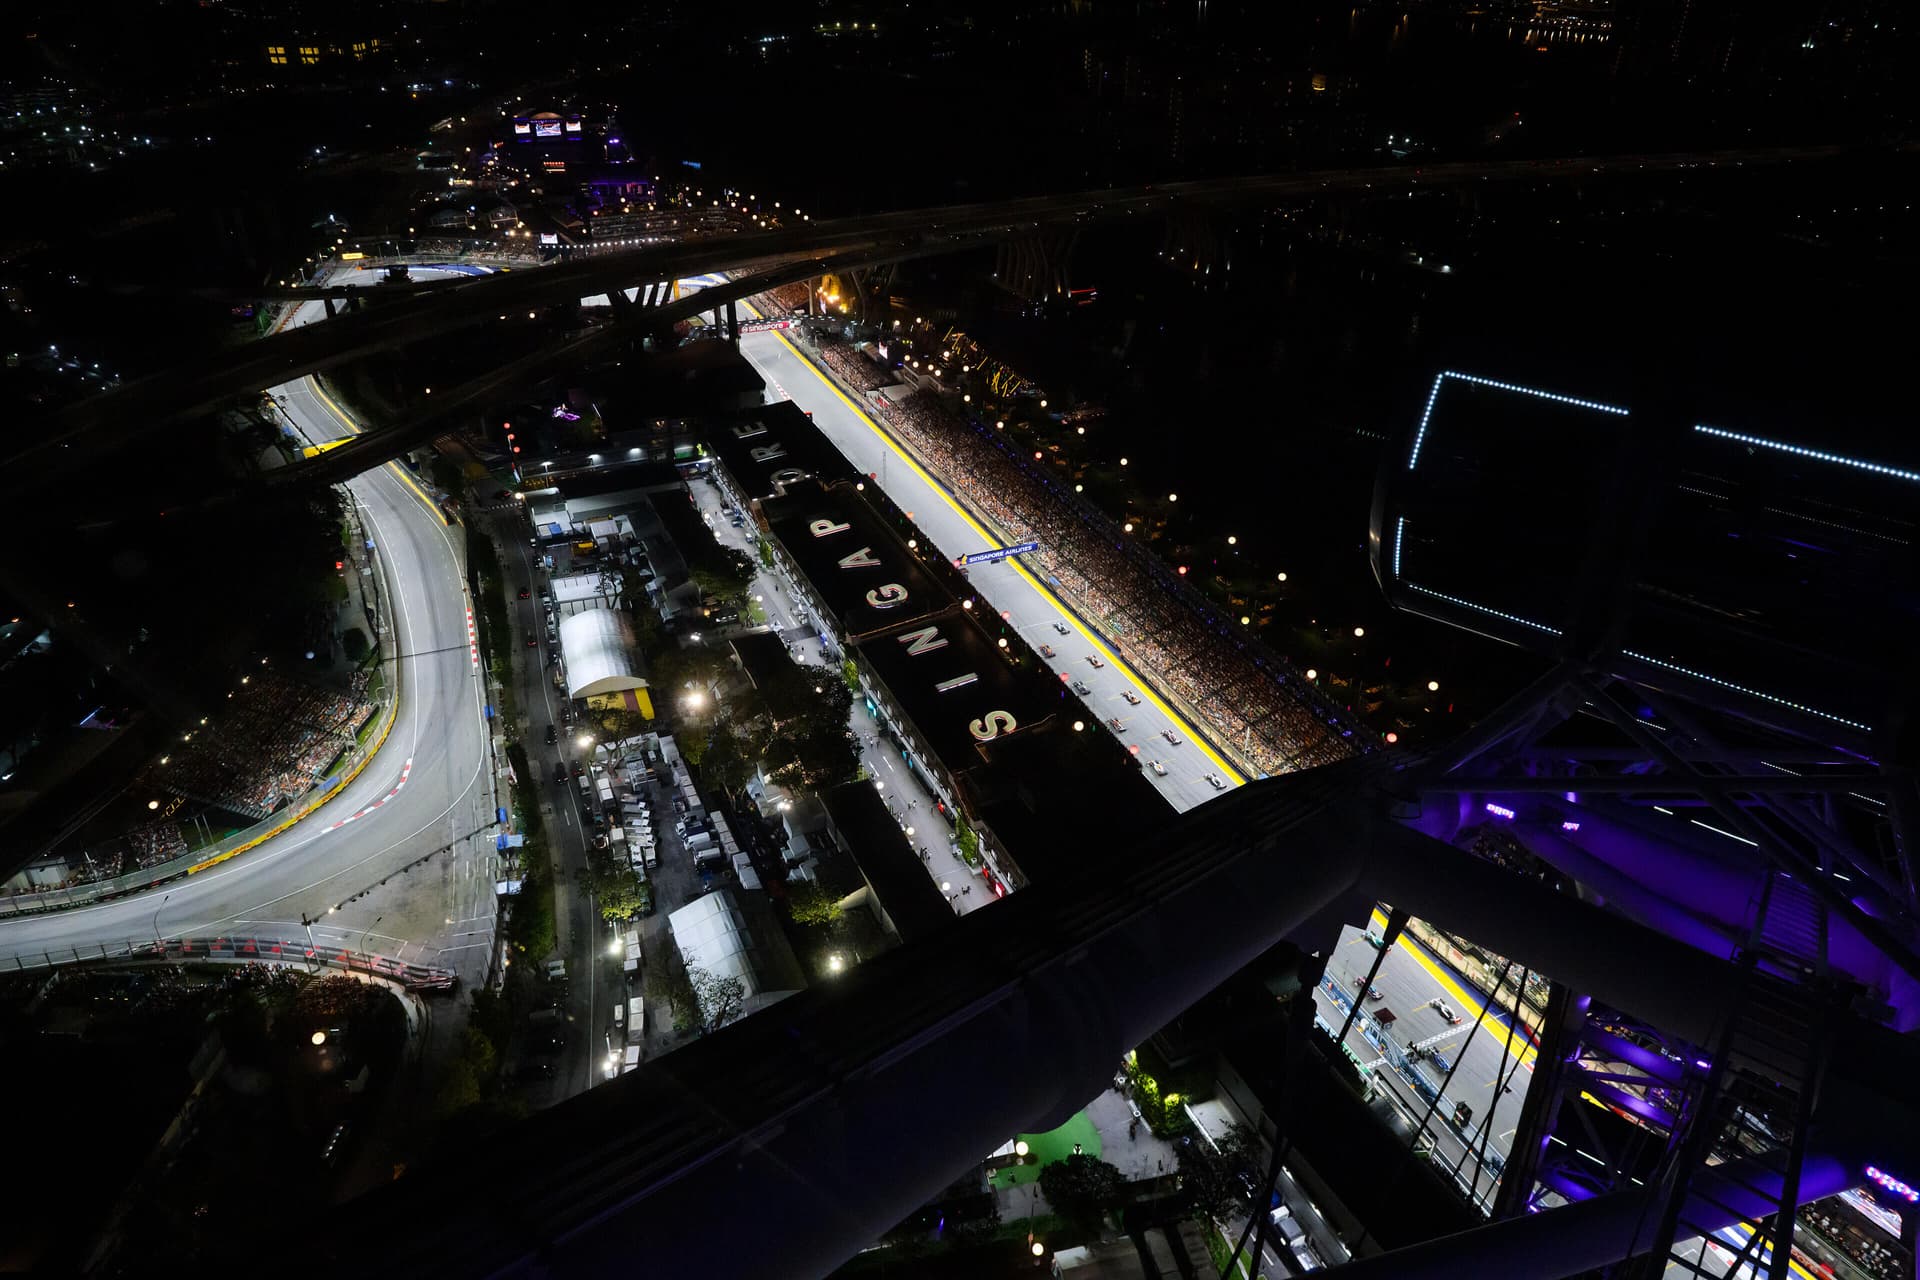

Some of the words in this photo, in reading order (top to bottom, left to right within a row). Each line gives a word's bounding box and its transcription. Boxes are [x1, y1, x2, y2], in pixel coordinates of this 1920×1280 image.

[731, 420, 1017, 743] SINGAPORE
[968, 551, 1004, 563] SINGAPORE
[1004, 544, 1033, 555] AIRLINES
